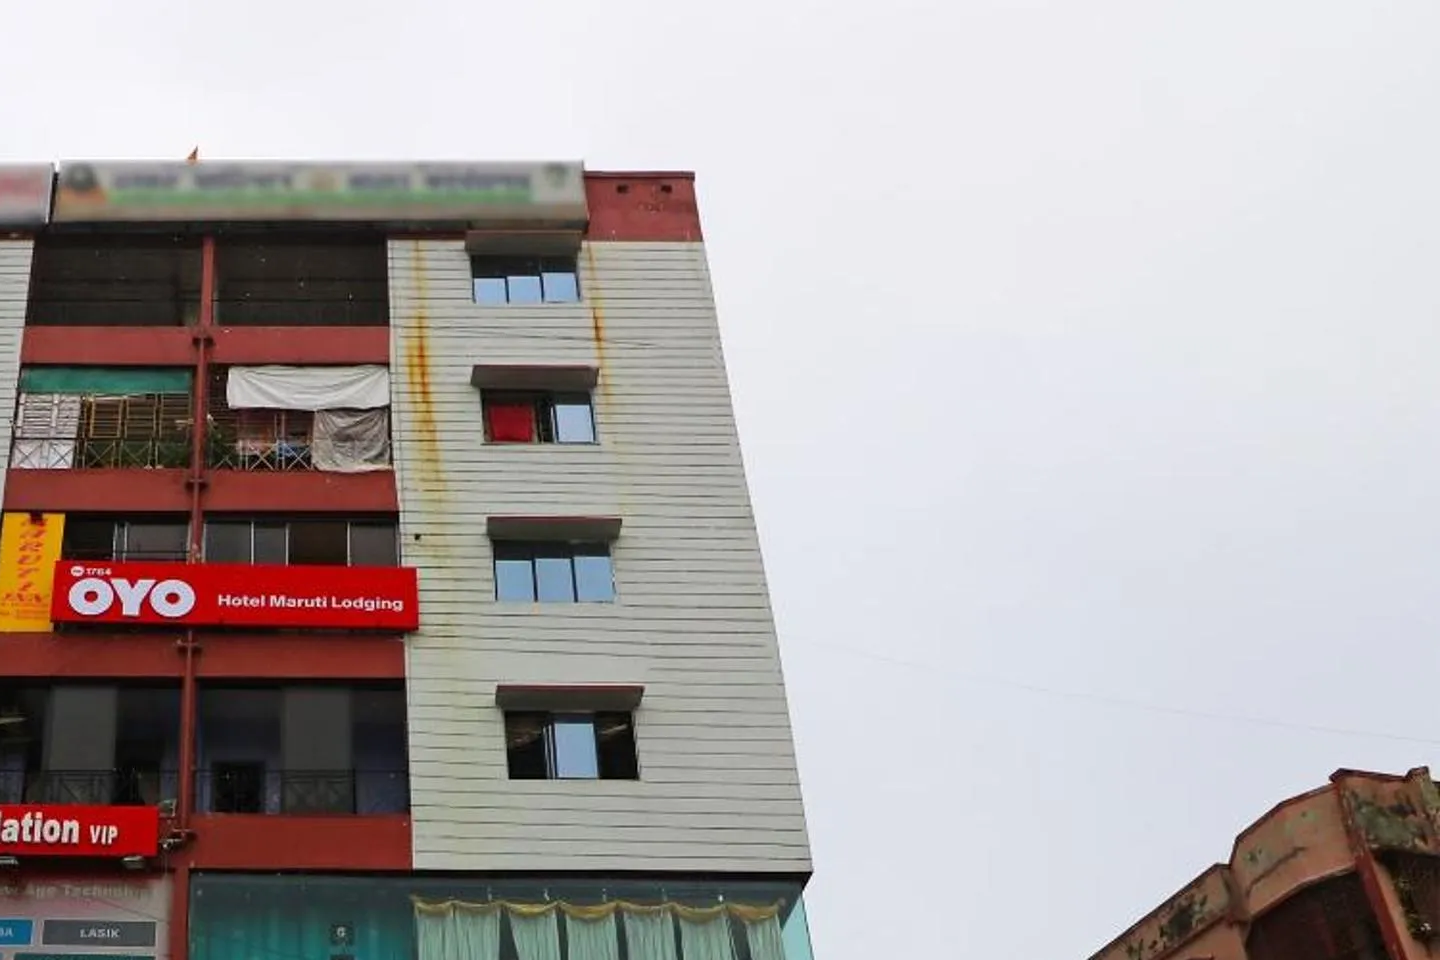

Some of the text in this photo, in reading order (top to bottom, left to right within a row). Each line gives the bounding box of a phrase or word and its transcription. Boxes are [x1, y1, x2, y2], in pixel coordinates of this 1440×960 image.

[68, 577, 196, 617] OYO
[218, 594, 403, 612] Hotel Maruti Lodging
[89, 824, 119, 845] VIP
[79, 928, 121, 939] LASIK
